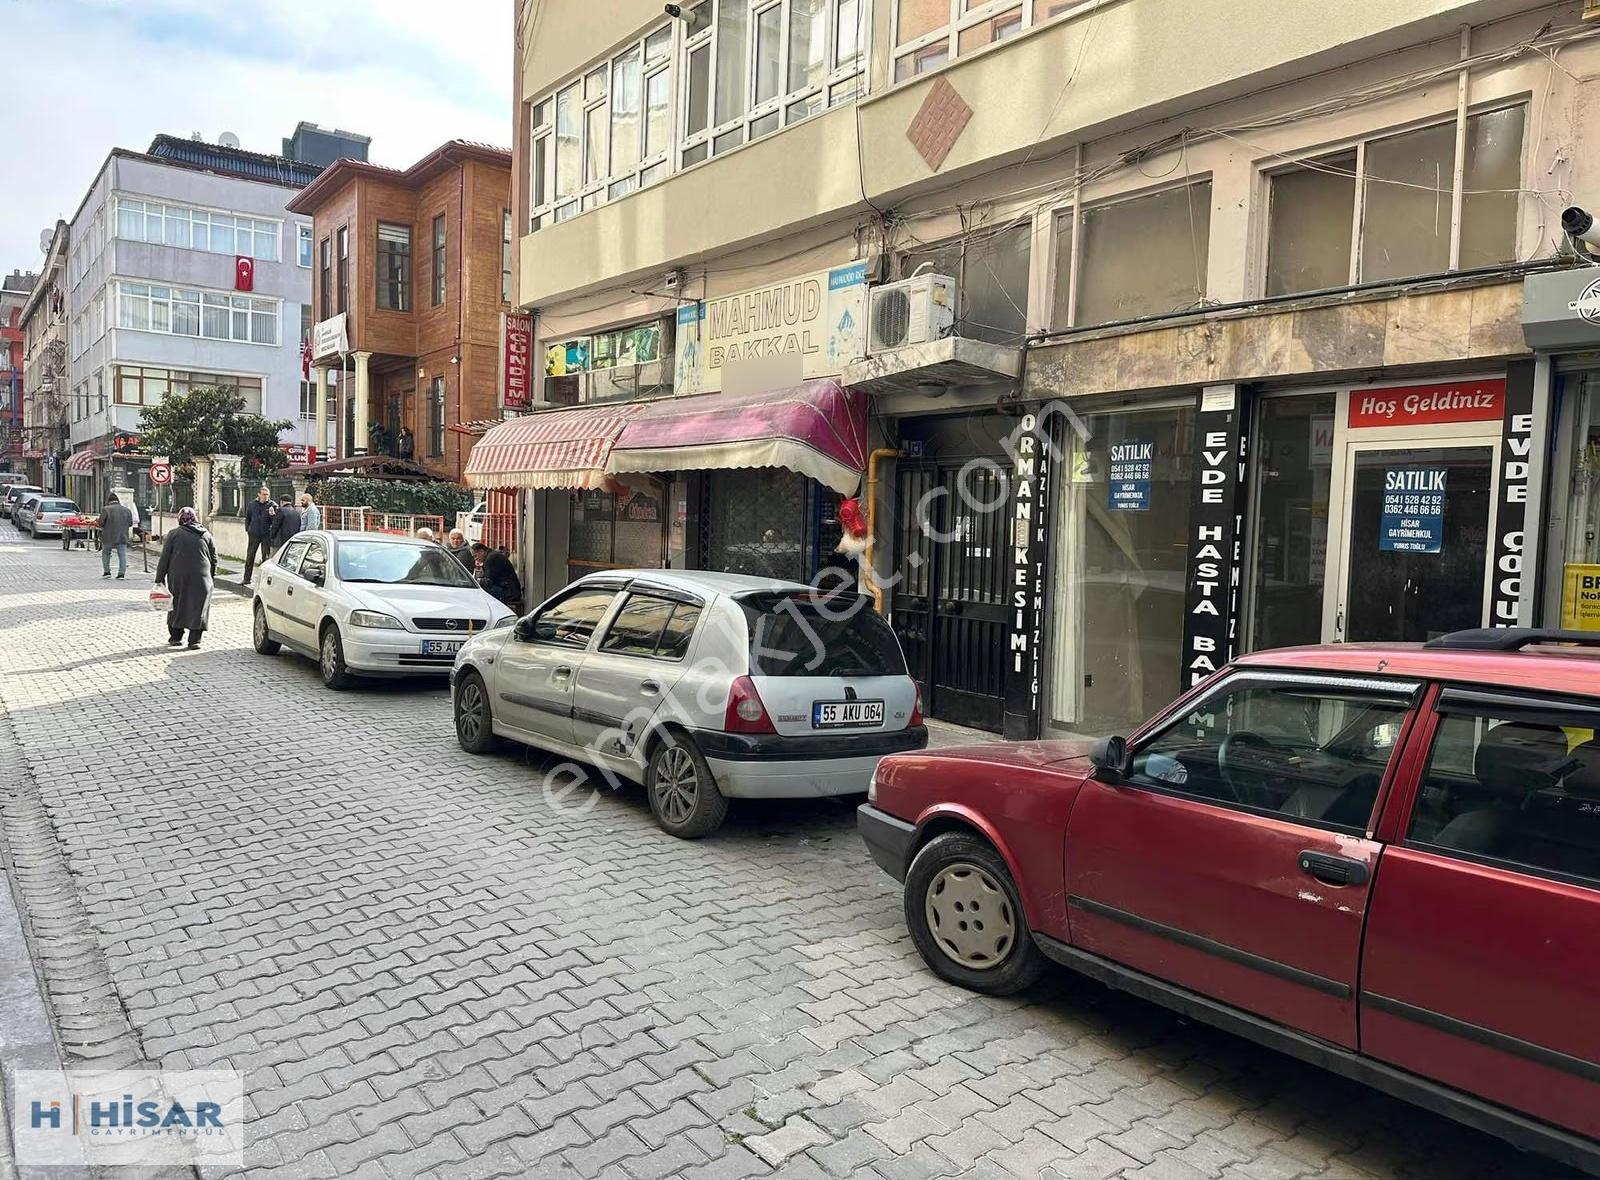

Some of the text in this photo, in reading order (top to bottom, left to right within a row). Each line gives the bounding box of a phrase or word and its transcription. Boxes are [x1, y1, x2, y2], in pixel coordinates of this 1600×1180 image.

[507, 317, 530, 332] SALON
[709, 279, 820, 340] MAHMUD
[709, 330, 820, 369] BAKKAL
[1360, 389, 1496, 419] Hoş Geldiniz
[1016, 413, 1037, 520] ORMAN
[1111, 443, 1152, 461] SATILIK
[1238, 436, 1247, 483] EV
[1201, 431, 1229, 504] EVDE
[1385, 470, 1446, 490] SATILIK
[1037, 442, 1049, 542] YAZLIK
[1385, 494, 1442, 505] 0541 528 42 92
[1384, 504, 1441, 515] 0362 446 66 56
[1400, 518, 1421, 528] HİSAR
[1192, 525, 1223, 616] HASTA
[1496, 531, 1525, 629] ÇOCU
[428, 641, 442, 652] 55
[823, 705, 837, 721] 55
[843, 705, 861, 721] AKU
[864, 704, 881, 720] 064
